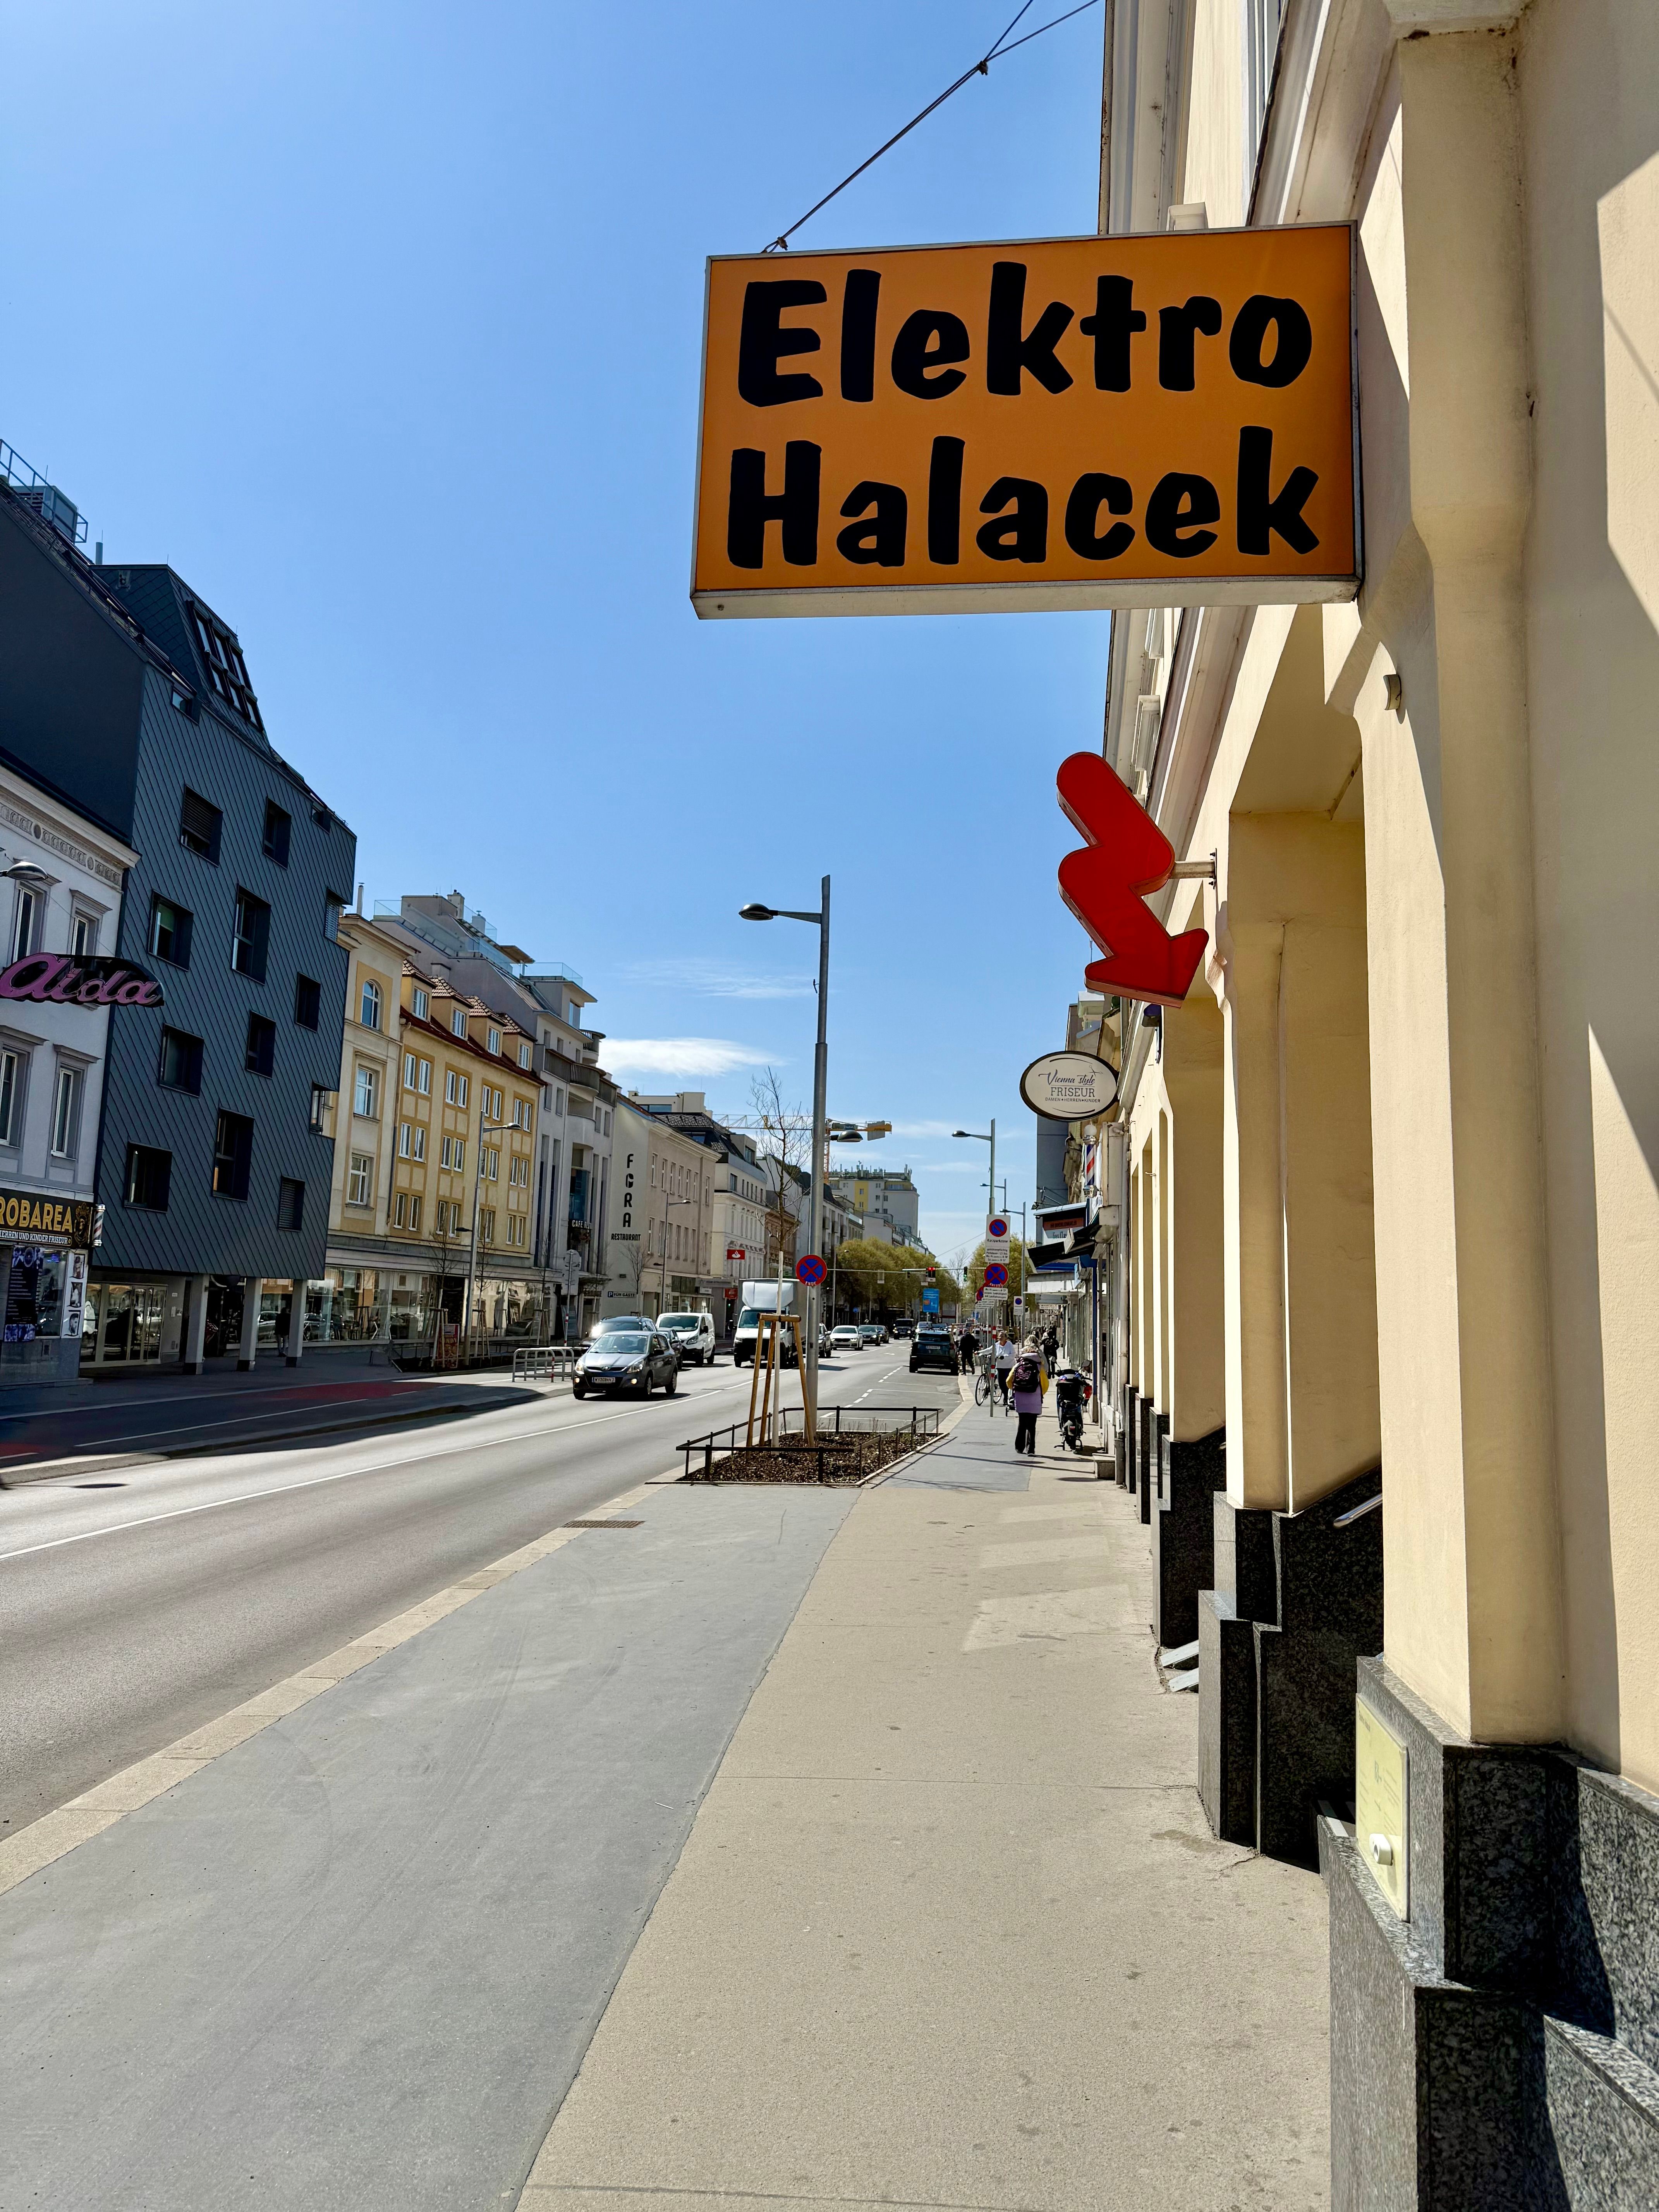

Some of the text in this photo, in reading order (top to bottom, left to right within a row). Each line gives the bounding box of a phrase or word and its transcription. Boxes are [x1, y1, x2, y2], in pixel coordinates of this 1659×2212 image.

[738, 261, 1313, 407] Elektro
[727, 425, 1320, 569] Halacek
[0, 952, 161, 1005] Aida
[1038, 1069, 1095, 1085] Vienna style
[1050, 1087, 1095, 1097] FRISEUR
[572, 1220, 583, 1228] CAFE
[19, 1232, 30, 1240] UND
[30, 1233, 48, 1242] KINDER
[48, 1236, 68, 1245] FRISEUR
[611, 1233, 641, 1241] RESTAURANT
